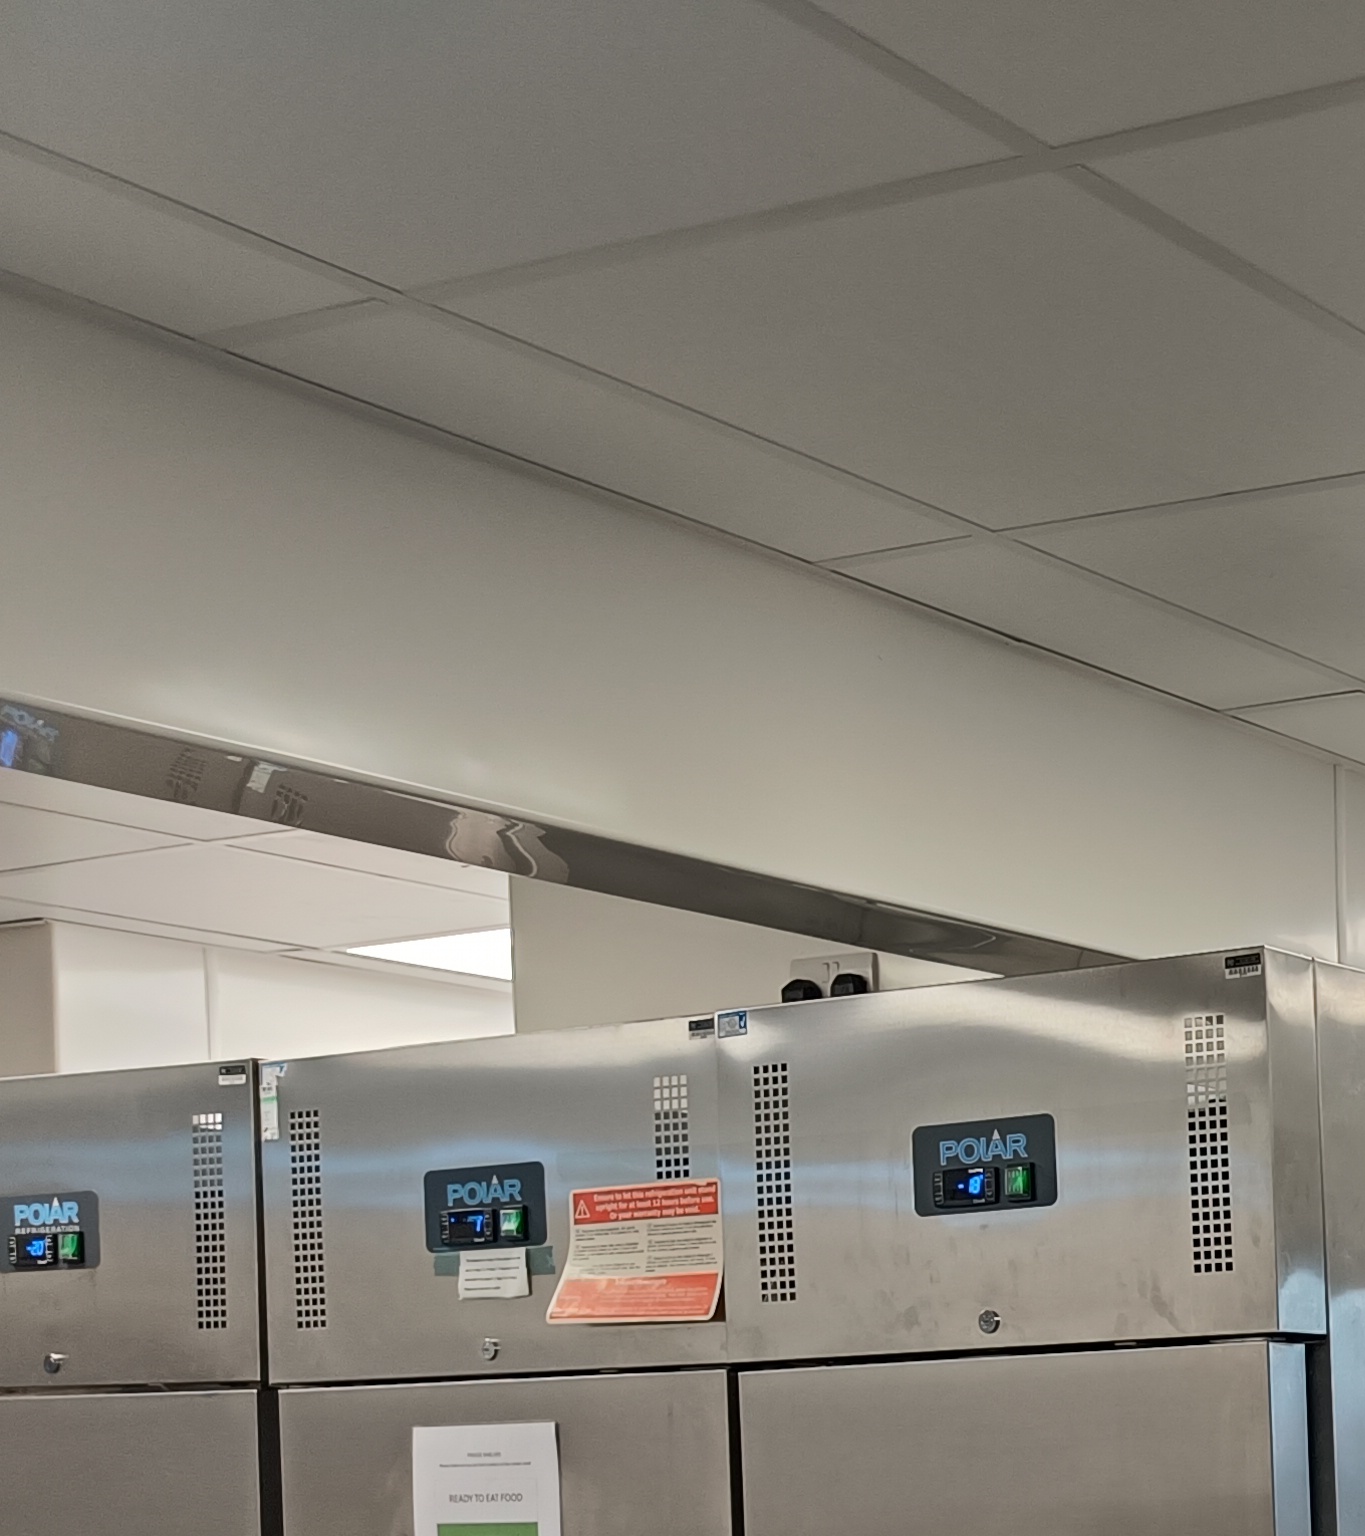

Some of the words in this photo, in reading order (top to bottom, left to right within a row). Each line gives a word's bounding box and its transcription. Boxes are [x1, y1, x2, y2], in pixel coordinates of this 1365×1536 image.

[939, 1129, 1028, 1166] POLAR
[447, 1174, 522, 1207] POLAR
[14, 1197, 80, 1227] POLAR
[15, 1225, 80, 1235] REFRIGERATION
[449, 1494, 473, 1503] READY
[474, 1494, 485, 1503] TO
[486, 1493, 499, 1502] EAT
[500, 1493, 523, 1502] FOOD
